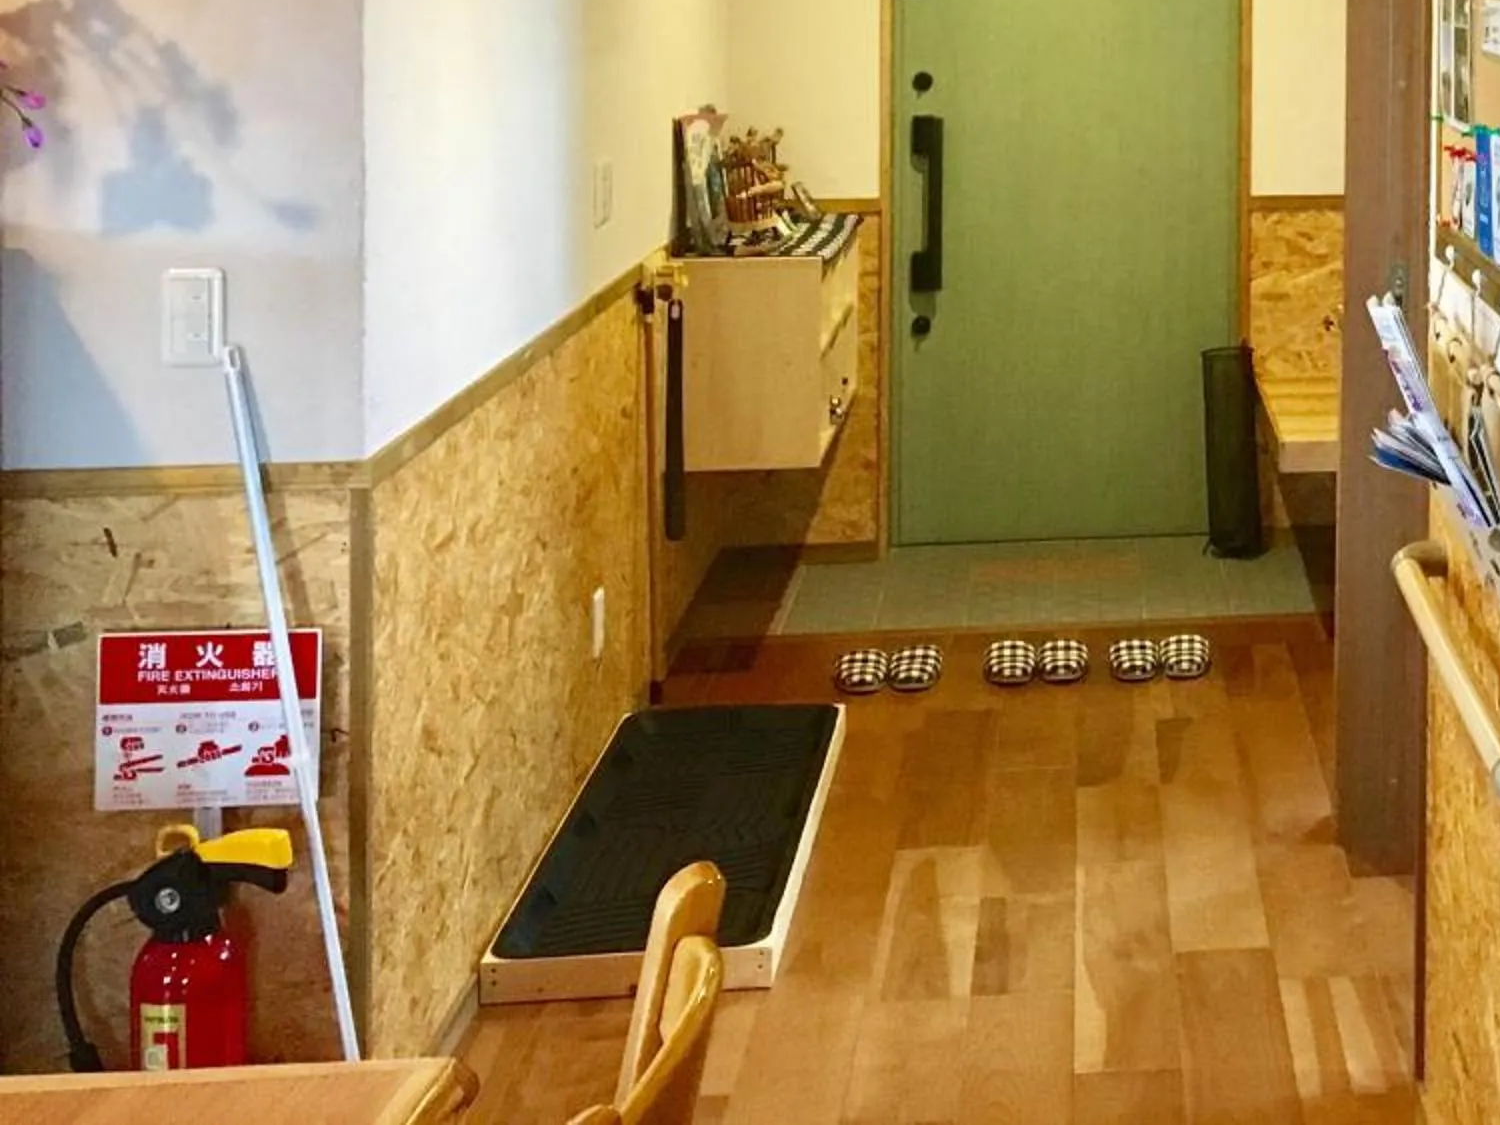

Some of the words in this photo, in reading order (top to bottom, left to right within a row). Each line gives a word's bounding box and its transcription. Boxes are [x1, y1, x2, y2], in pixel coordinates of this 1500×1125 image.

[137, 641, 277, 669] 消火器
[137, 670, 171, 682] FIRE
